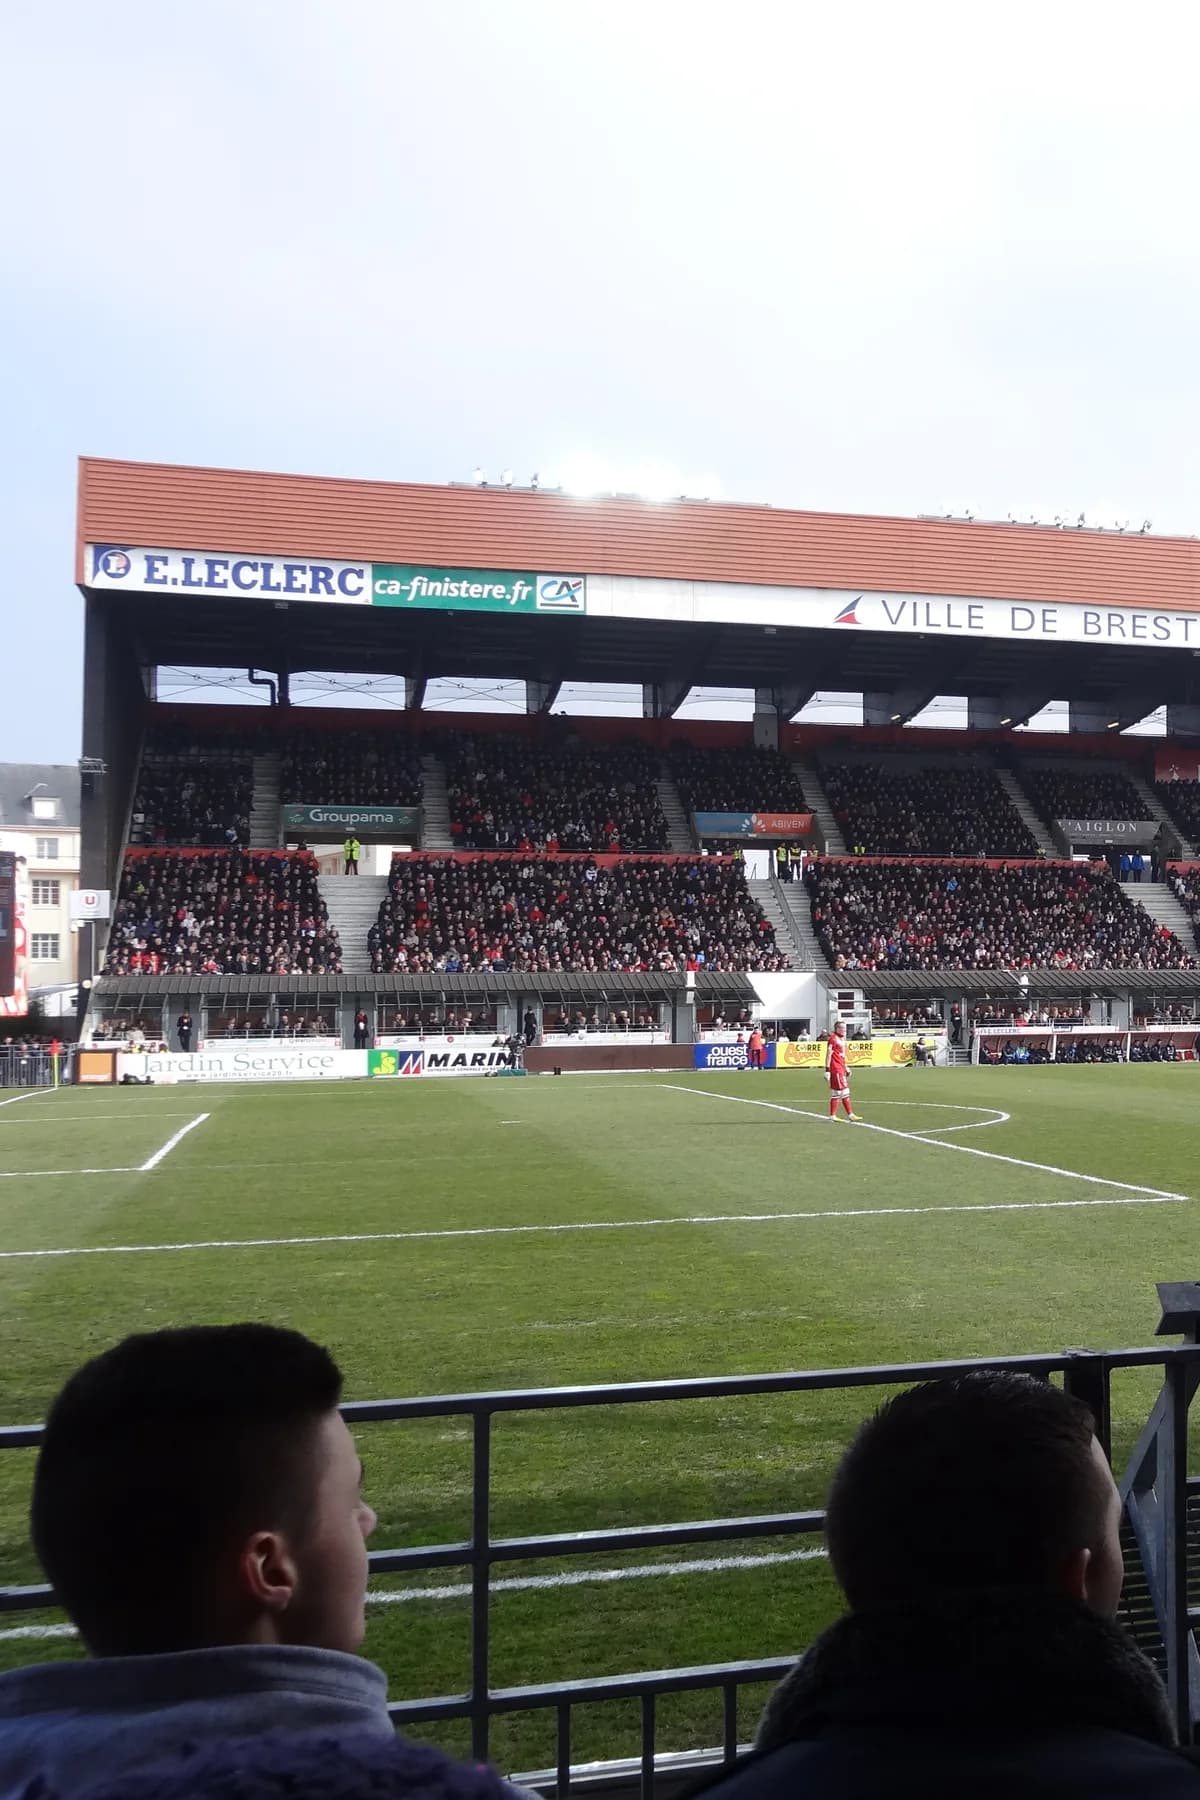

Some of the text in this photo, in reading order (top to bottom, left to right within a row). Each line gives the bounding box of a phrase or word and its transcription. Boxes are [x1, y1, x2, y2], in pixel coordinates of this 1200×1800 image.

[143, 555, 366, 597] E.LECLERC
[374, 576, 532, 605] ca-finistere.fr
[881, 599, 1198, 642] VILLE DE BREST
[309, 808, 394, 825] Groupama
[705, 1053, 748, 1066] france
[711, 1044, 748, 1057] ouest
[140, 1052, 335, 1076] Jardin Service
